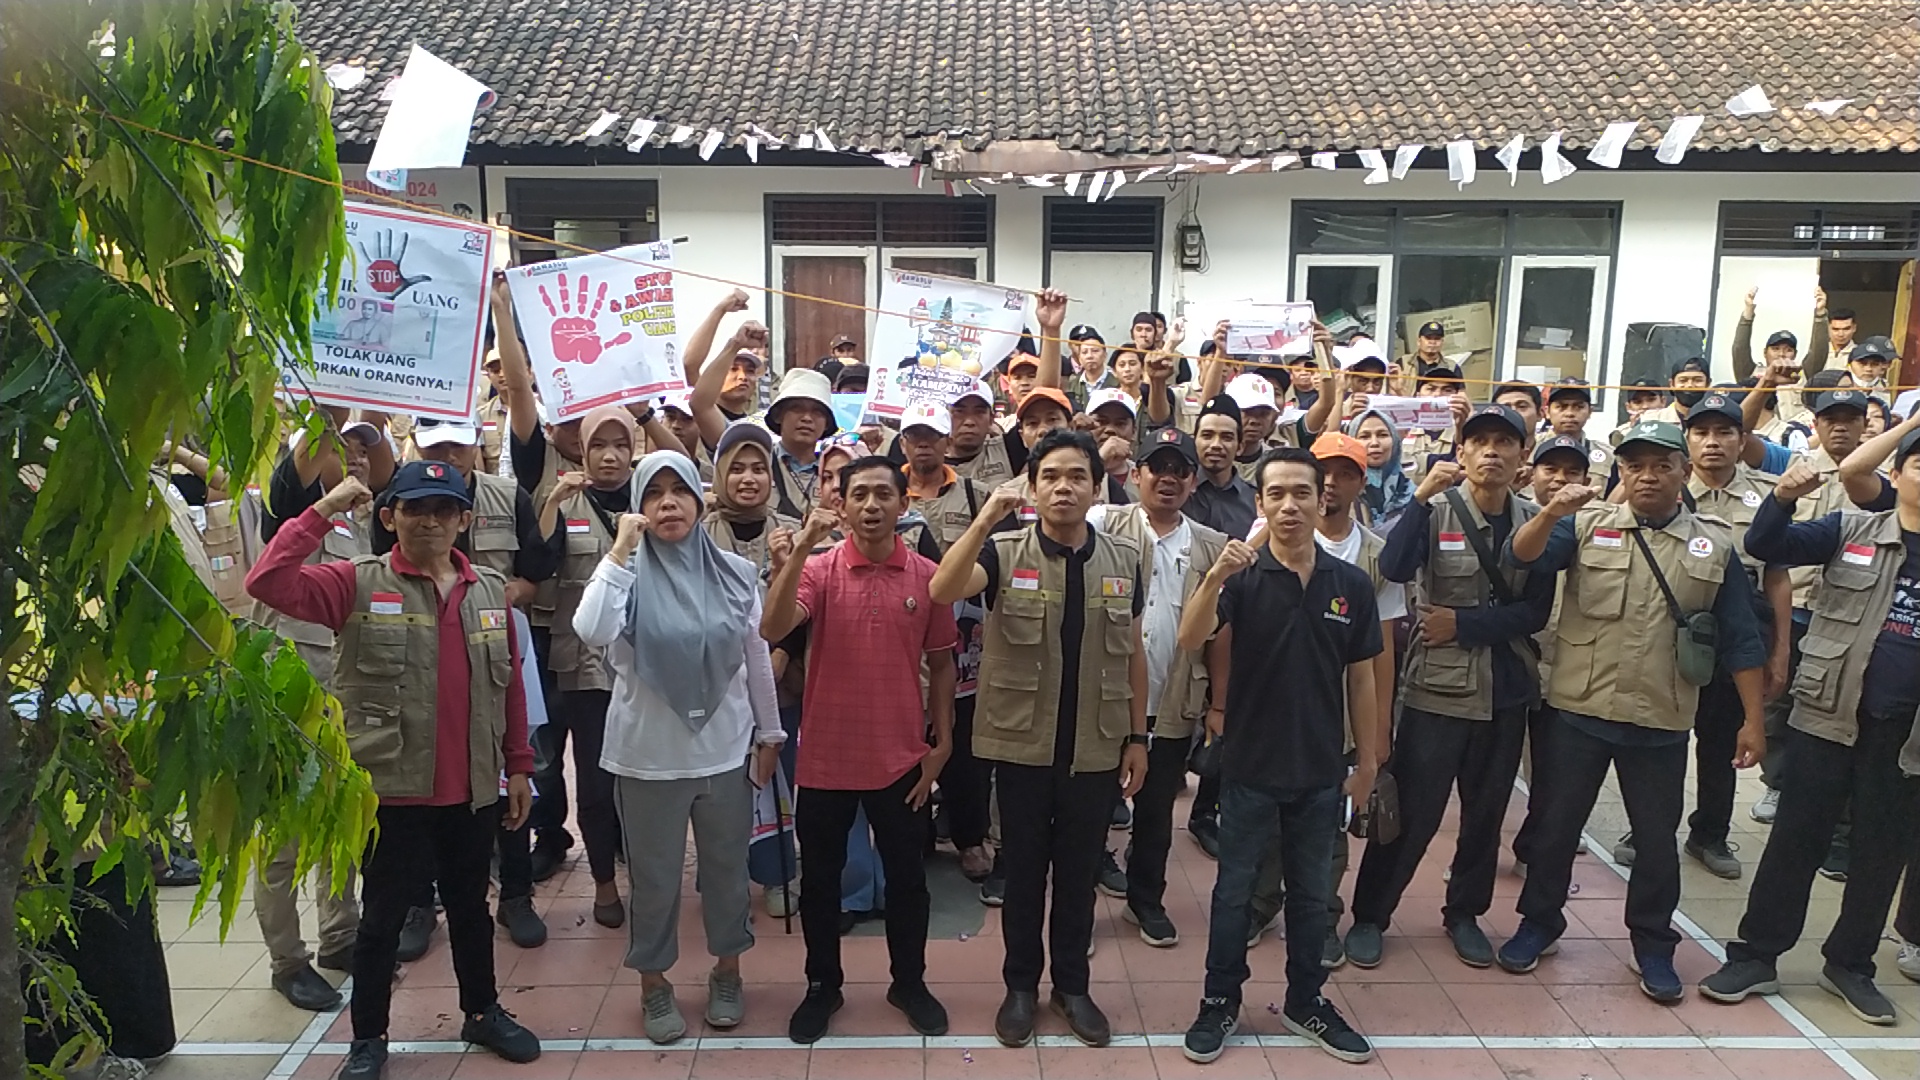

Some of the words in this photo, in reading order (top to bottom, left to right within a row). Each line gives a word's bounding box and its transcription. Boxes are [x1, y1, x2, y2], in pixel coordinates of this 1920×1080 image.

[406, 181, 437, 197] 024
[367, 269, 401, 283] STOP
[412, 290, 459, 310] UANG
[325, 344, 371, 362] TOLAK
[375, 352, 416, 369] UANG
